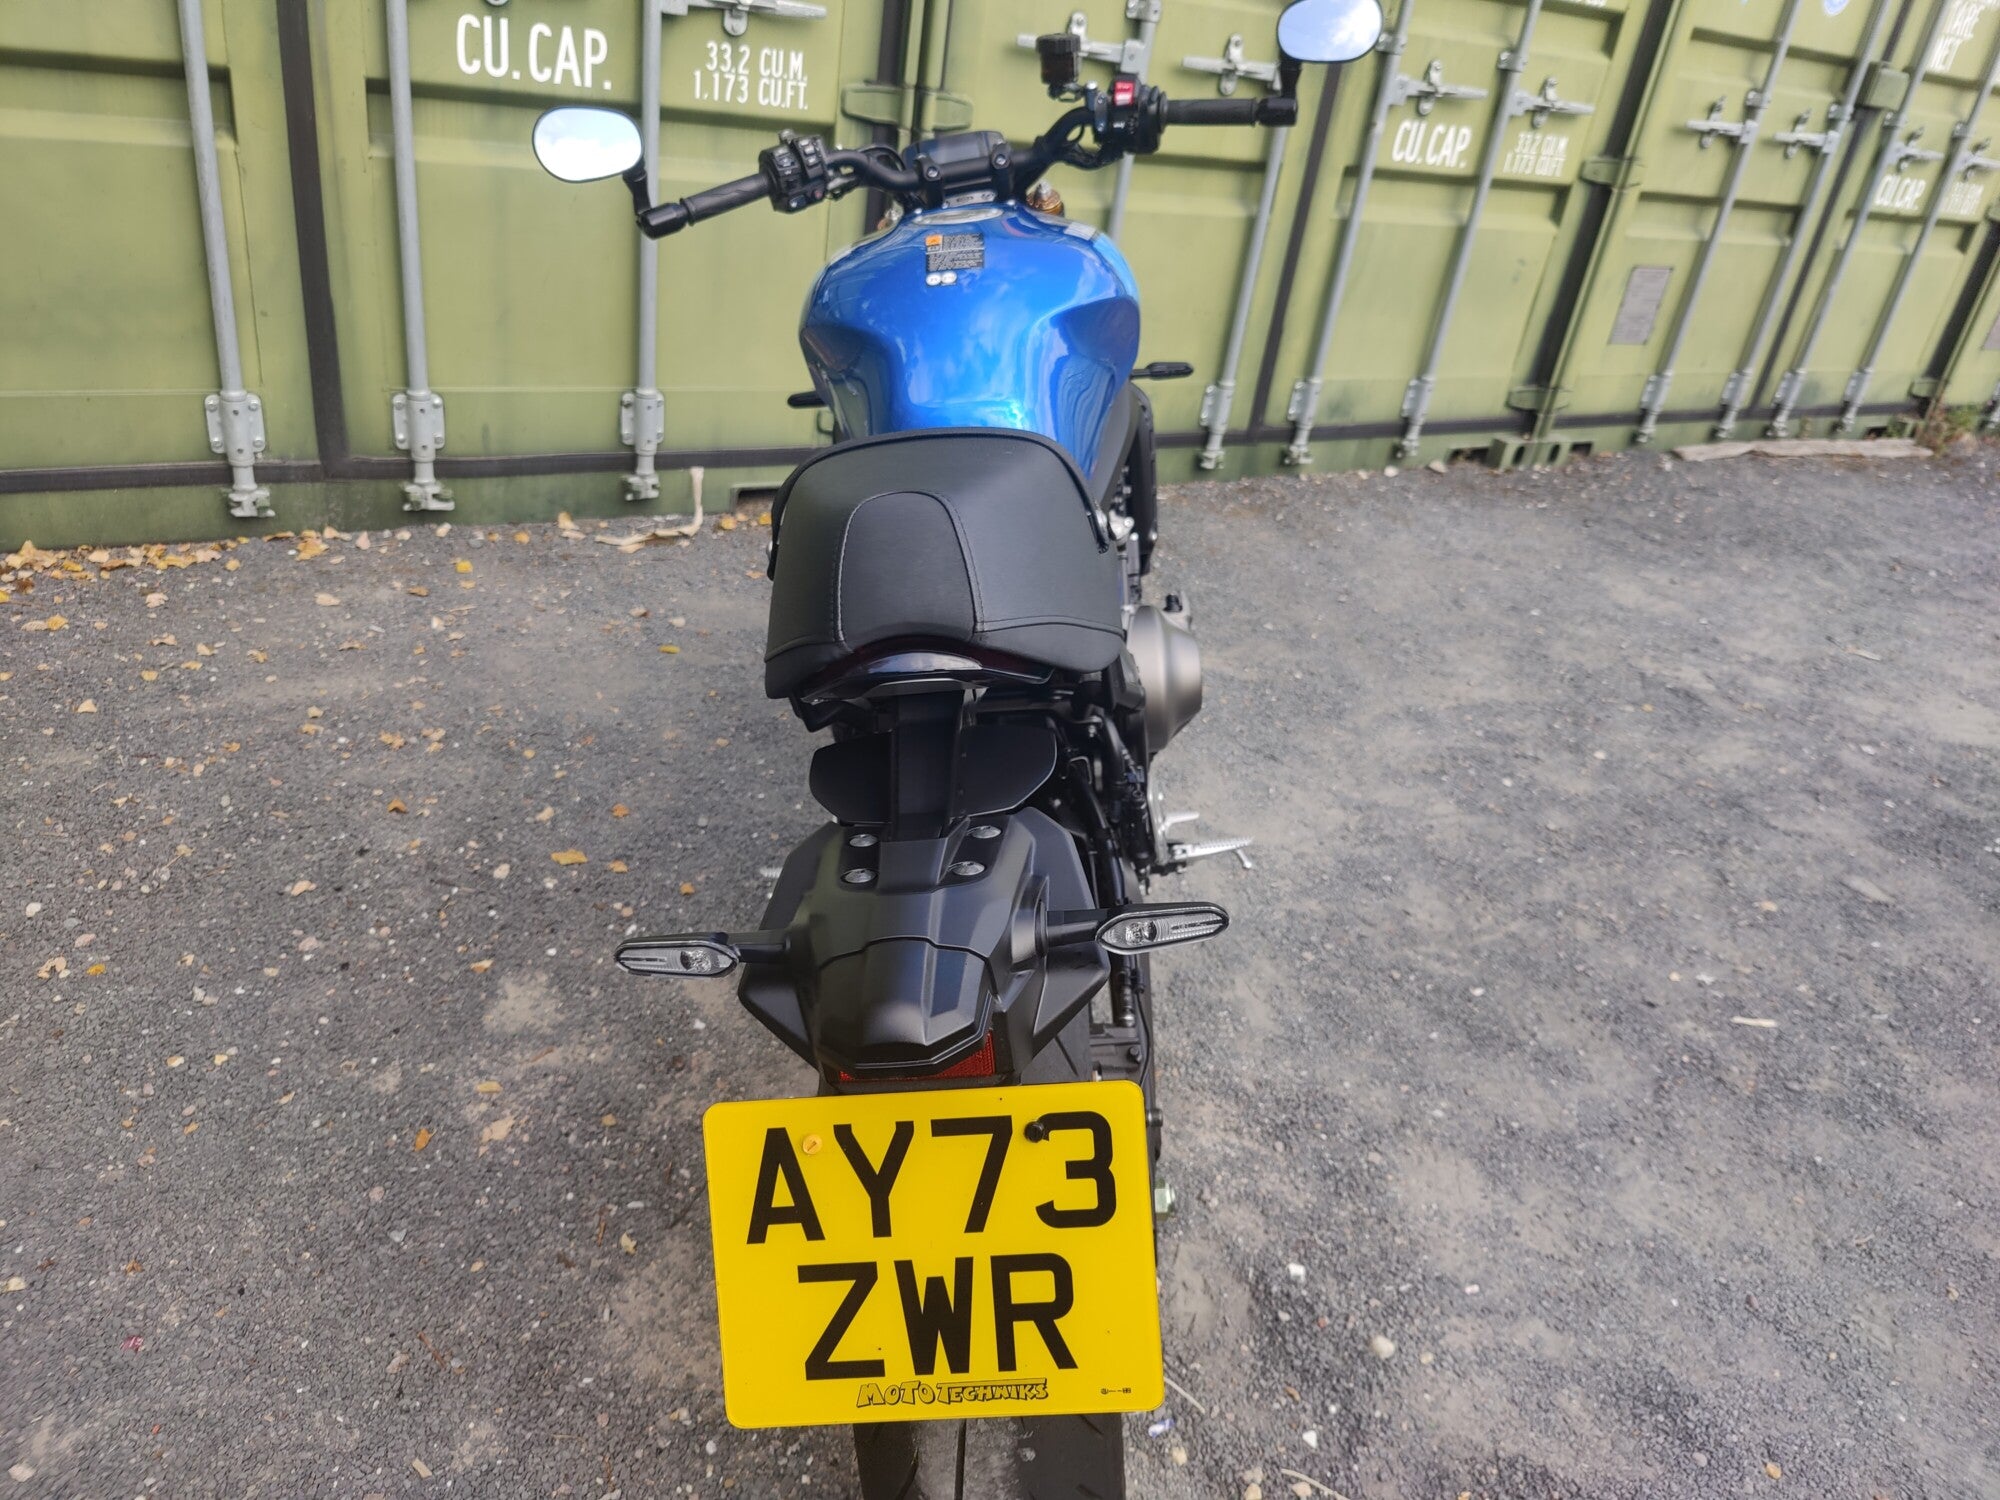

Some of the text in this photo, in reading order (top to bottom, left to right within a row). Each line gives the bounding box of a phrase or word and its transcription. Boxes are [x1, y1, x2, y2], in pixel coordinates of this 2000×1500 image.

[705, 40, 808, 82] 33.2 CU.M.
[758, 78, 808, 110] CU.FT.
[746, 1110, 1118, 1245] AY73
[797, 1252, 1079, 1381] ZWR
[856, 1377, 1049, 1408] MOTO TECHNIKS
